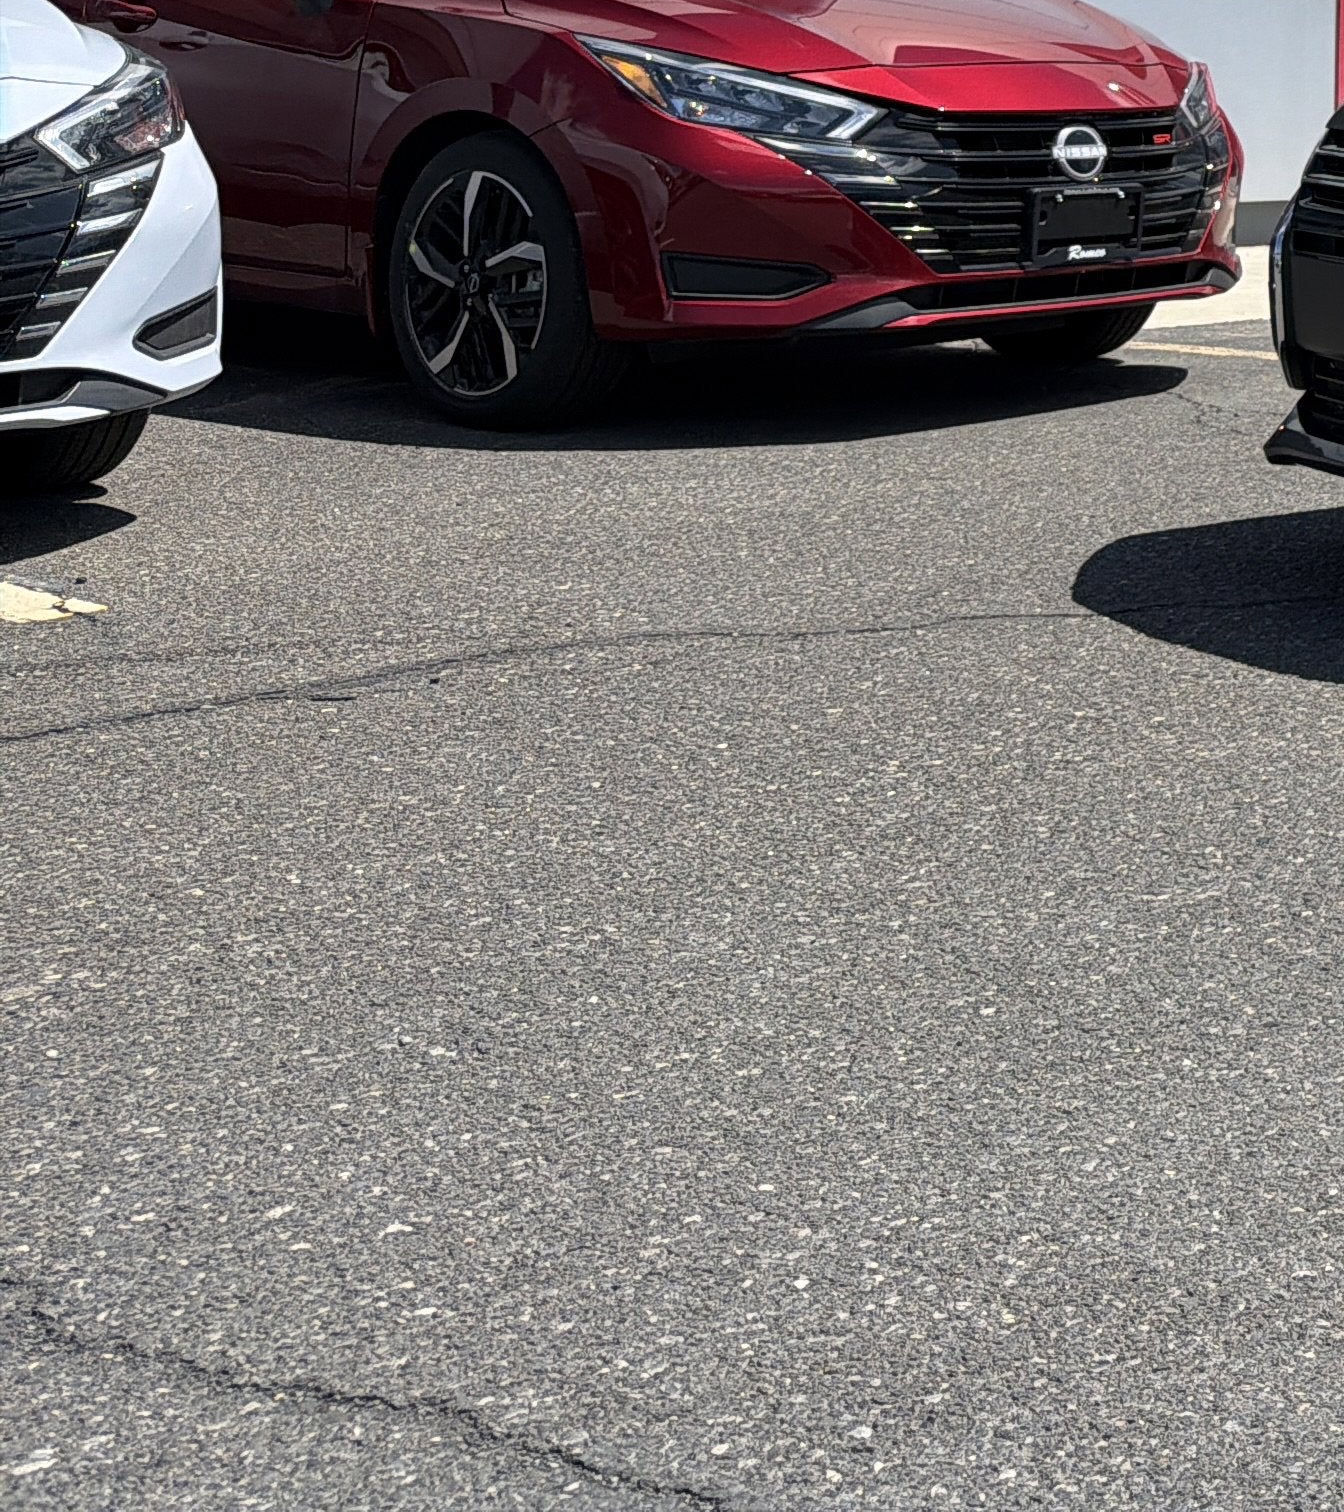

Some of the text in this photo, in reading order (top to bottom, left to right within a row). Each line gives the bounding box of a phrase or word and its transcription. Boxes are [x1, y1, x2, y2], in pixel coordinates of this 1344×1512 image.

[1153, 134, 1171, 145] SR
[1053, 146, 1106, 158] NISSAN
[1067, 245, 1106, 261] Romeo
